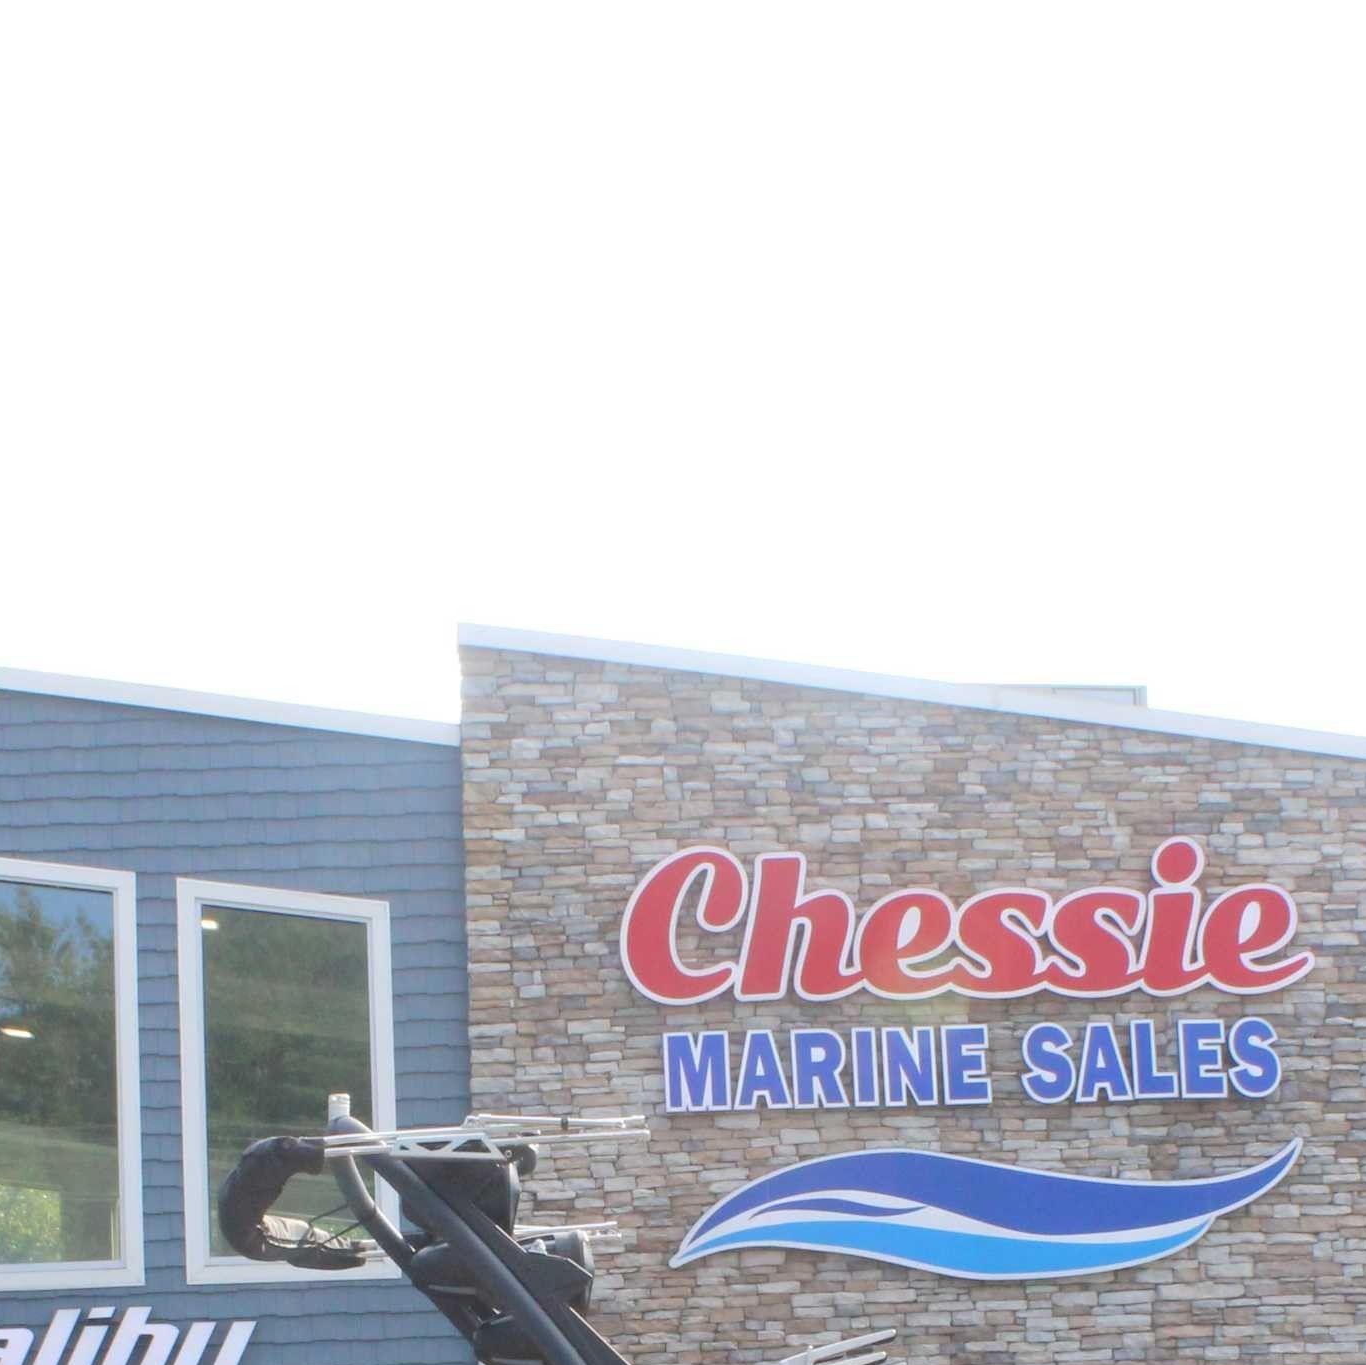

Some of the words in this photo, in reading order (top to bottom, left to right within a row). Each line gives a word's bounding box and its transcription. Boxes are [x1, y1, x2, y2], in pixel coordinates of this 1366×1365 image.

[621, 836, 1315, 1005] Chessie
[663, 1024, 993, 1113] MARINE
[1022, 1016, 1281, 1102] SALES
